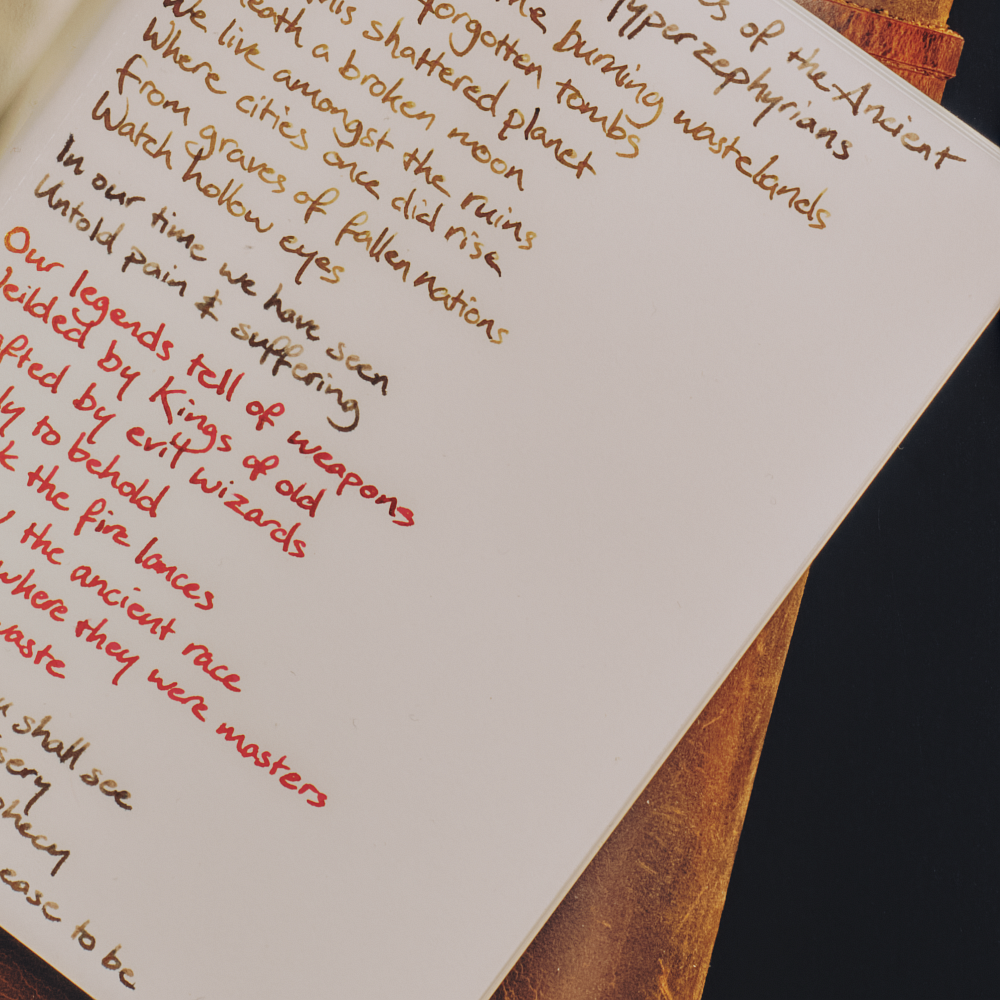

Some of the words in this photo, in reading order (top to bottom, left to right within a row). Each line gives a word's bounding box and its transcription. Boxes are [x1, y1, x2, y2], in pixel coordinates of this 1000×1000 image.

[142, 16, 227, 95] Where
[235, 94, 309, 151] cities
[322, 150, 380, 201] once
[390, 187, 444, 233] did
[444, 225, 502, 278] rise
[217, 18, 265, 72] live
[272, 69, 395, 153] amongst
[402, 147, 451, 198] the
[460, 191, 537, 251] ruins
[311, 43, 330, 63] a
[338, 48, 437, 131] broken
[447, 127, 525, 192] moon
[362, 16, 511, 118] shattered
[497, 106, 597, 180] planet
[552, 18, 665, 130] burning
[673, 109, 831, 230] wastelands
[555, 78, 641, 159] tombs
[739, 19, 786, 53] of
[786, 47, 831, 93] the
[831, 82, 967, 170] Ancient
[56, 133, 85, 176] In
[91, 172, 146, 208] our
[150, 205, 207, 262] time
[218, 262, 257, 297] we
[262, 282, 321, 342] have
[325, 342, 389, 397] seen
[91, 89, 191, 170] Watch
[181, 152, 275, 234] hollow
[278, 235, 345, 286] eyes
[115, 53, 191, 127] From
[185, 124, 287, 194] graves
[293, 187, 340, 225] of
[334, 210, 411, 283] fallen
[413, 270, 509, 345] nations
[3, 225, 65, 272] Our
[69, 269, 175, 362] legends
[186, 353, 246, 403] tell
[245, 400, 286, 432] of
[286, 429, 415, 527] weapons
[34, 173, 125, 255] Untold
[121, 245, 188, 298] pain
[229, 323, 361, 433] suffering
[31, 415, 62, 446] to
[67, 431, 171, 518] behold
[71, 381, 117, 445] by
[188, 452, 307, 559] wizards
[96, 339, 142, 402] by
[242, 454, 280, 482] of
[274, 479, 327, 518] old
[19, 521, 65, 566] the
[69, 564, 176, 641] ancient
[181, 642, 242, 693] race
[26, 464, 70, 512] the
[73, 497, 131, 548] fire
[134, 536, 215, 611] lances
[11, 715, 91, 771] shall
[79, 768, 133, 811] see
[74, 617, 141, 687] they
[146, 668, 209, 723] were
[215, 722, 328, 808] masters
[70, 919, 97, 952] to
[101, 943, 136, 991] be
